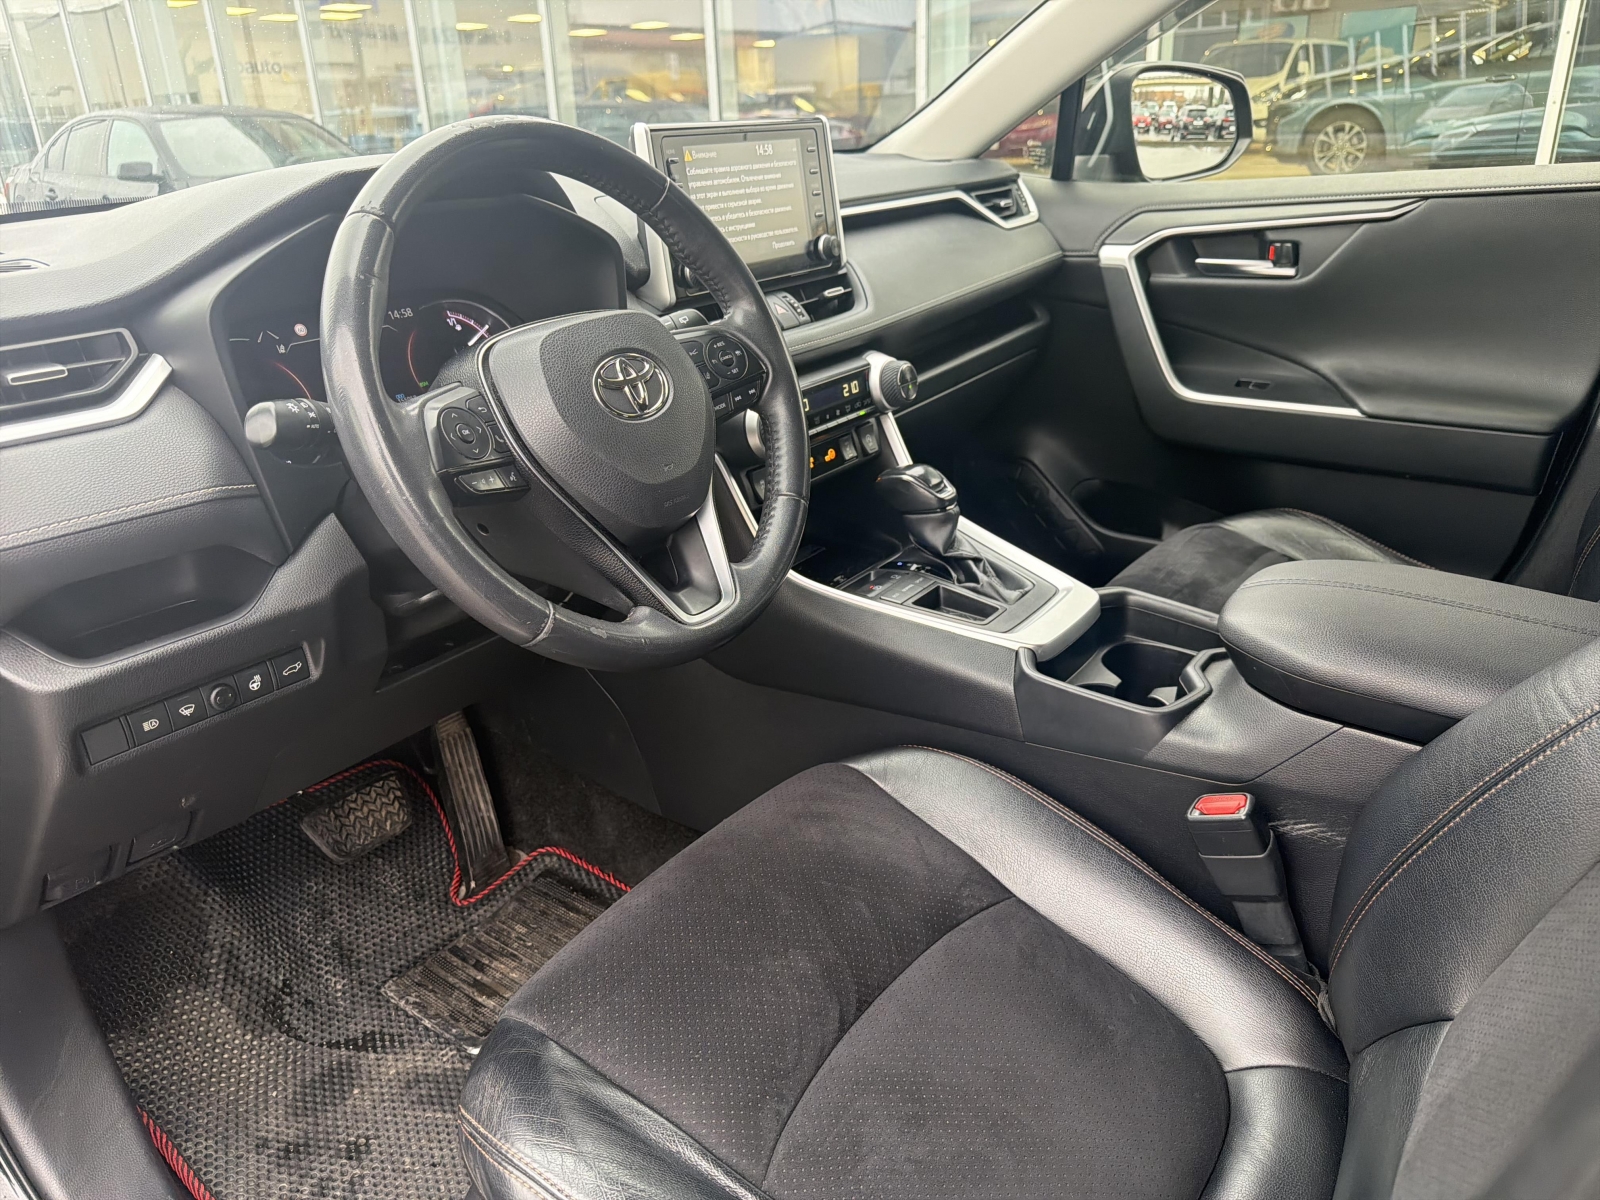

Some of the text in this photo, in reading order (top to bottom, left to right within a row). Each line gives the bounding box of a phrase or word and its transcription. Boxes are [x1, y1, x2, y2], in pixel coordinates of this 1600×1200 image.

[691, 150, 717, 159] Внимание
[755, 143, 773, 156] 14:58
[388, 307, 414, 320] 14:58
